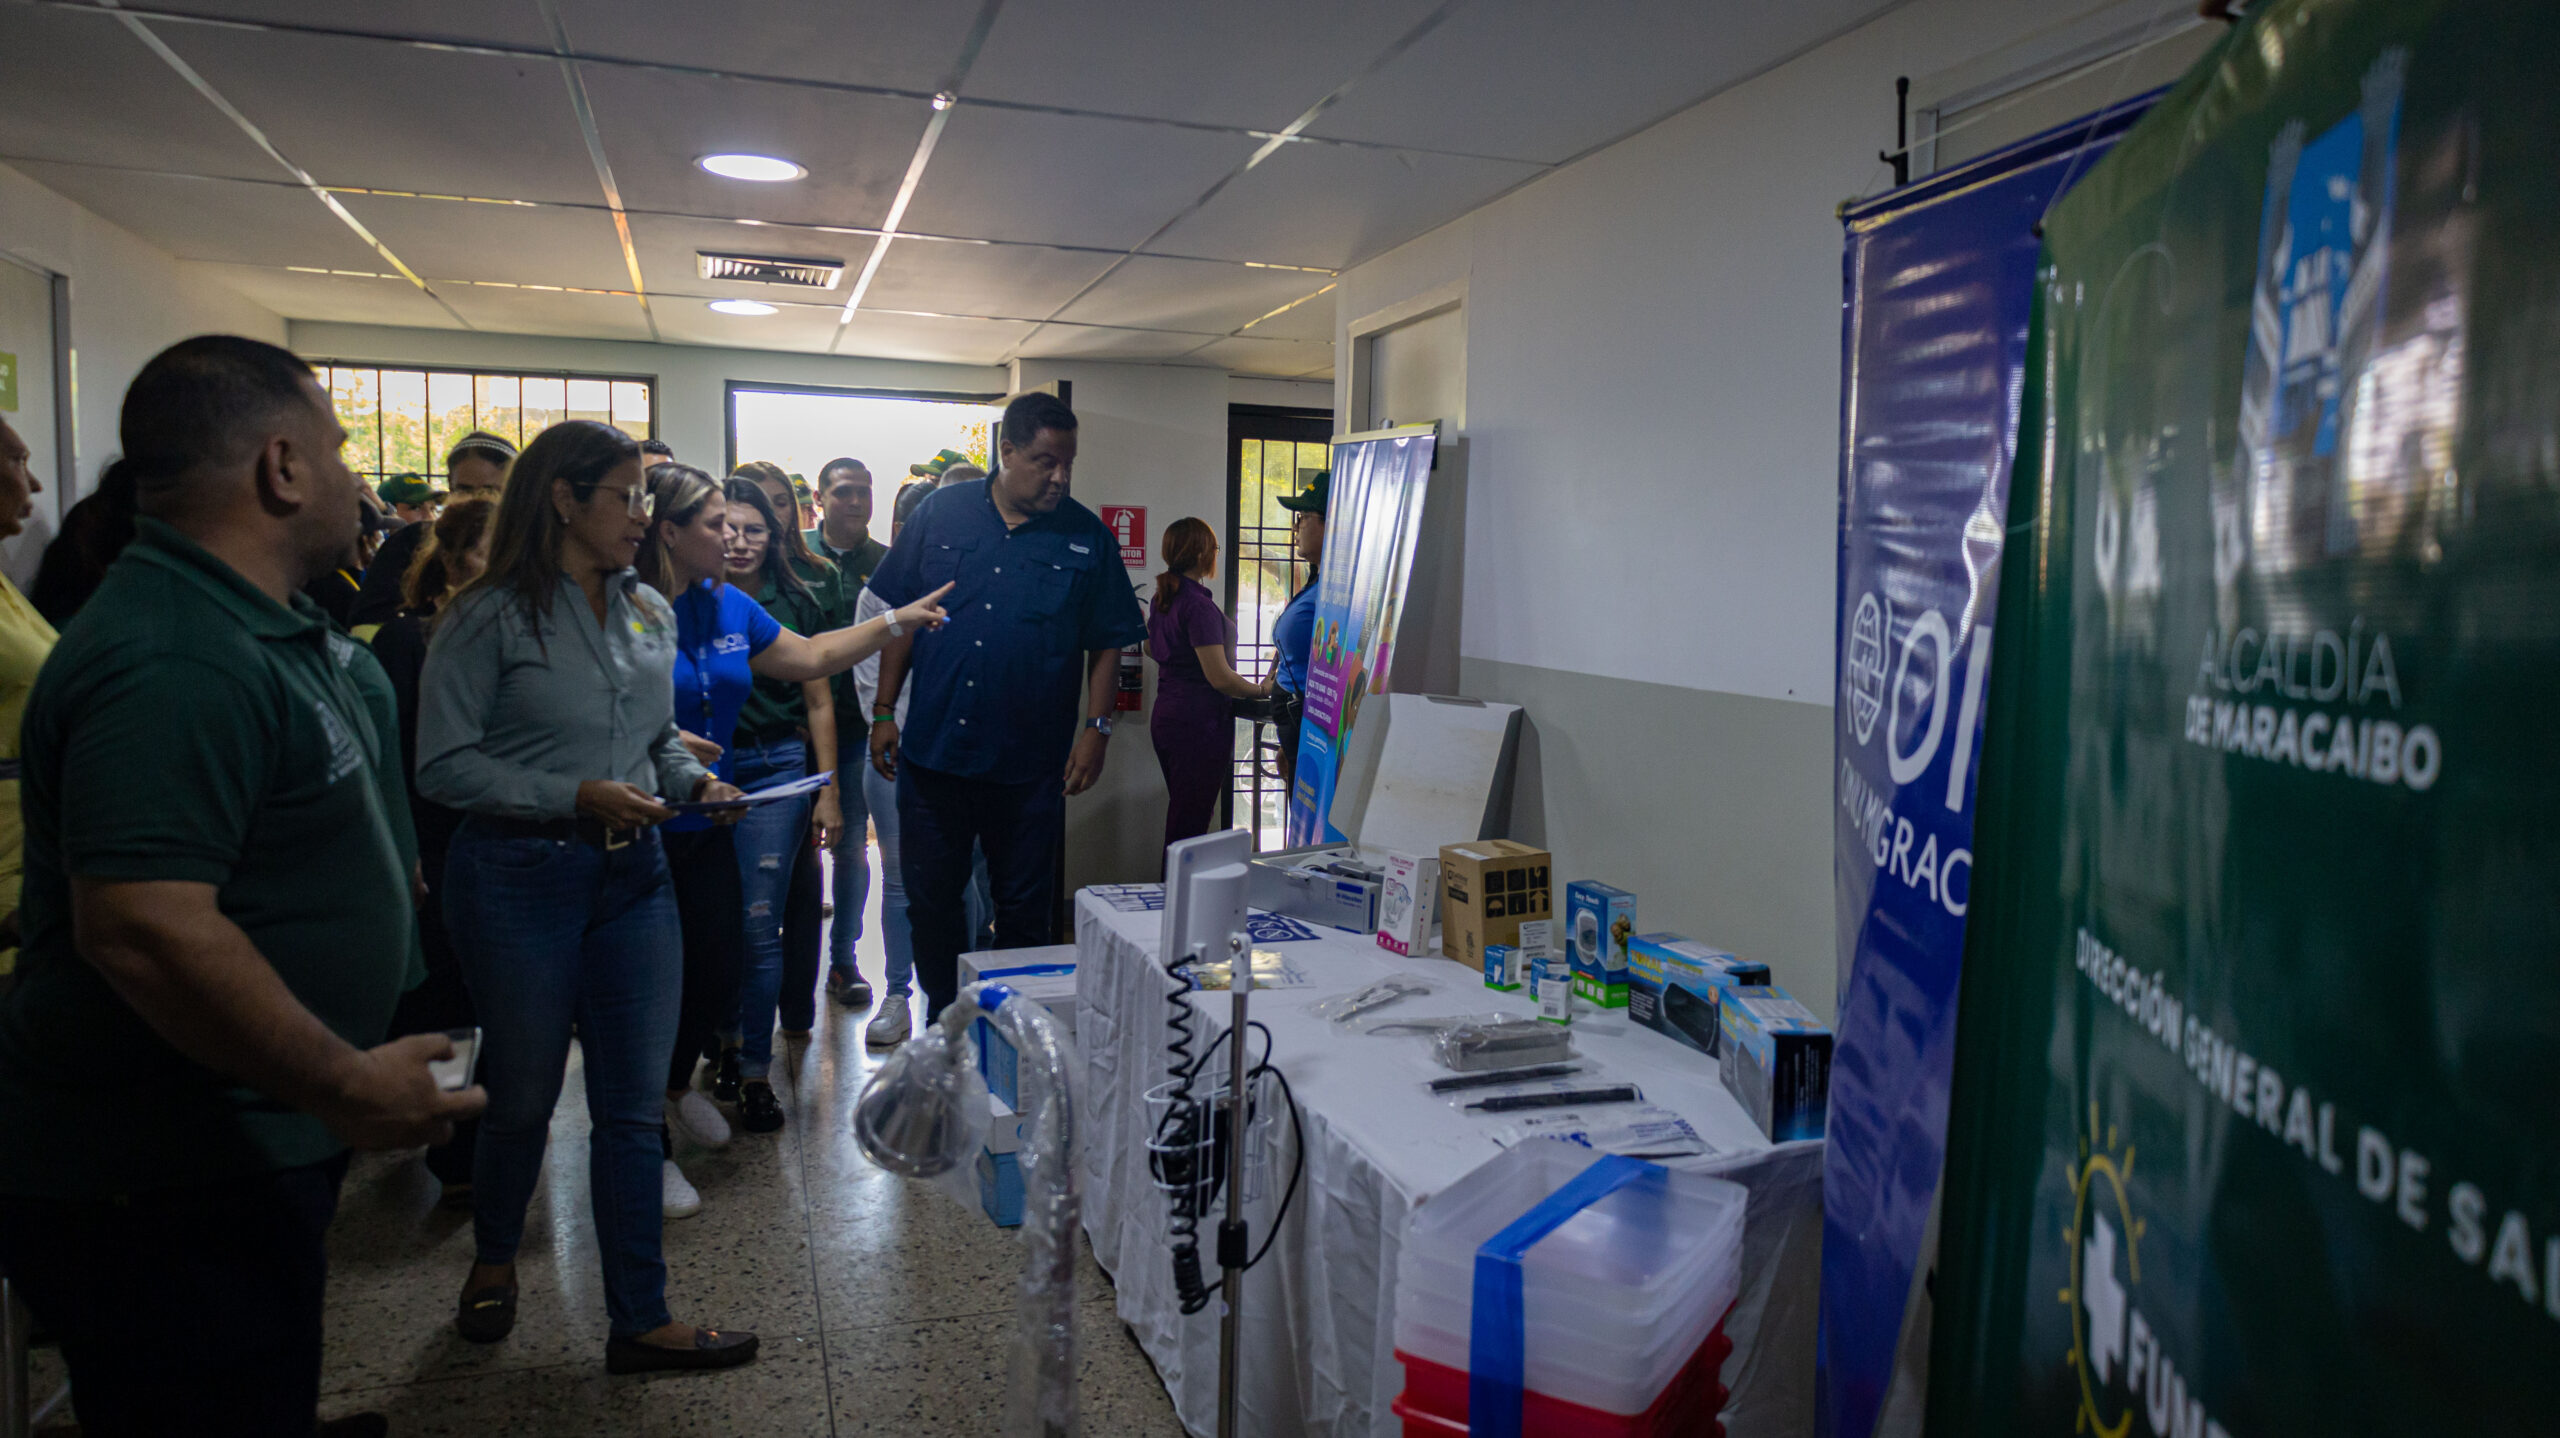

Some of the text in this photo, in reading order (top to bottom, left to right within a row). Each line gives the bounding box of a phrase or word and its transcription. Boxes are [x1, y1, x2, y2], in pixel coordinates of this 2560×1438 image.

[1119, 550, 1142, 558] NTOR
[1886, 608, 1993, 813] OI
[2197, 613, 2402, 710] ALCALDÍA
[2184, 694, 2442, 791] DE MARACAIBO
[1861, 785, 1974, 917] MIGRAC
[2076, 926, 2560, 1323] DIRECCIÓN GENERAL DE SAL
[2127, 1307, 2234, 1438] FUN
